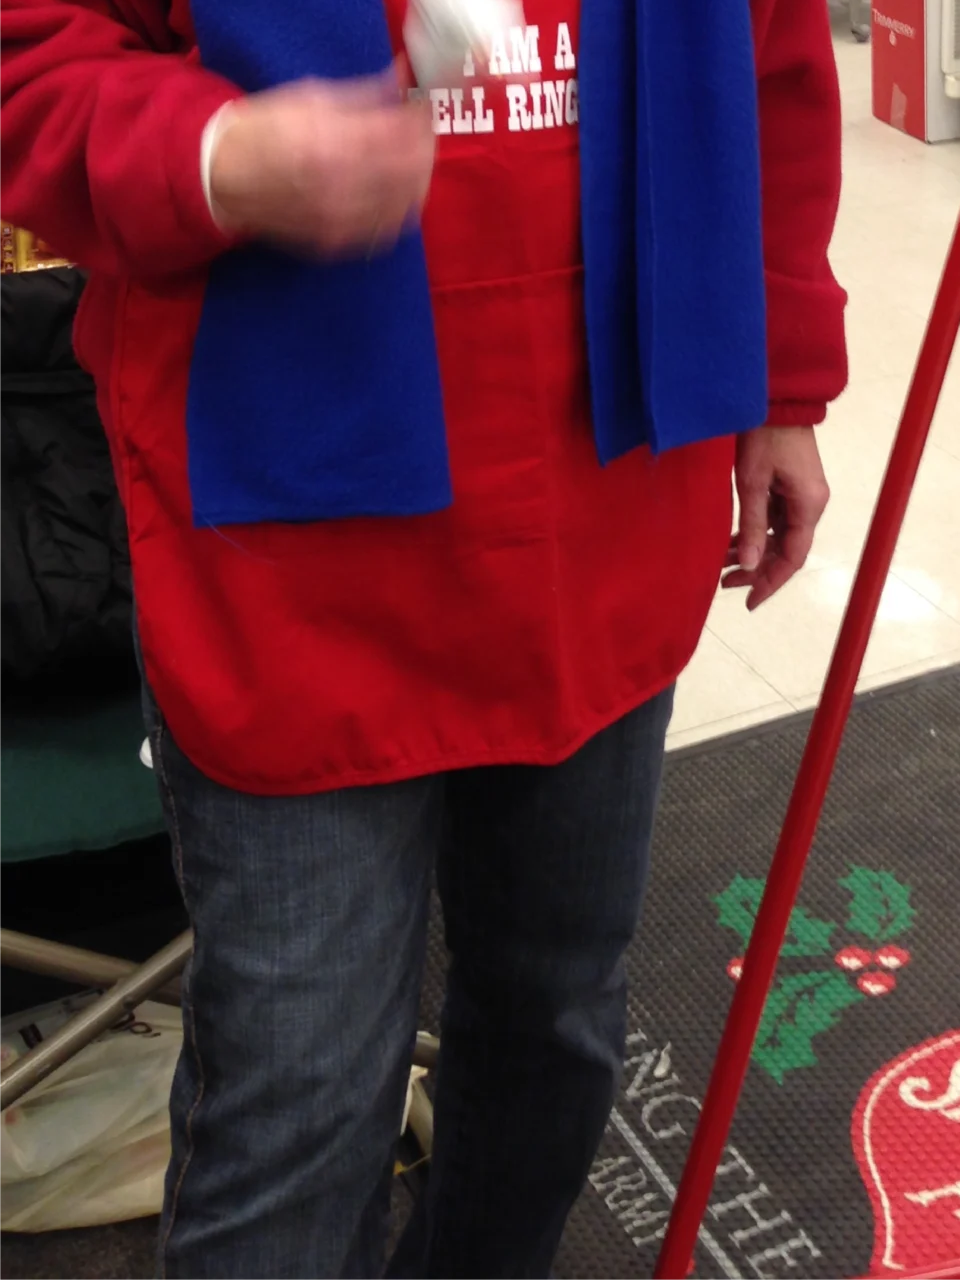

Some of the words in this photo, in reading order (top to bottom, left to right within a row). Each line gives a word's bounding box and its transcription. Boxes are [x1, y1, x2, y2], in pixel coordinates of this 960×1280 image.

[488, 24, 542, 76] AM
[554, 21, 577, 70] A
[407, 85, 495, 135] ELL
